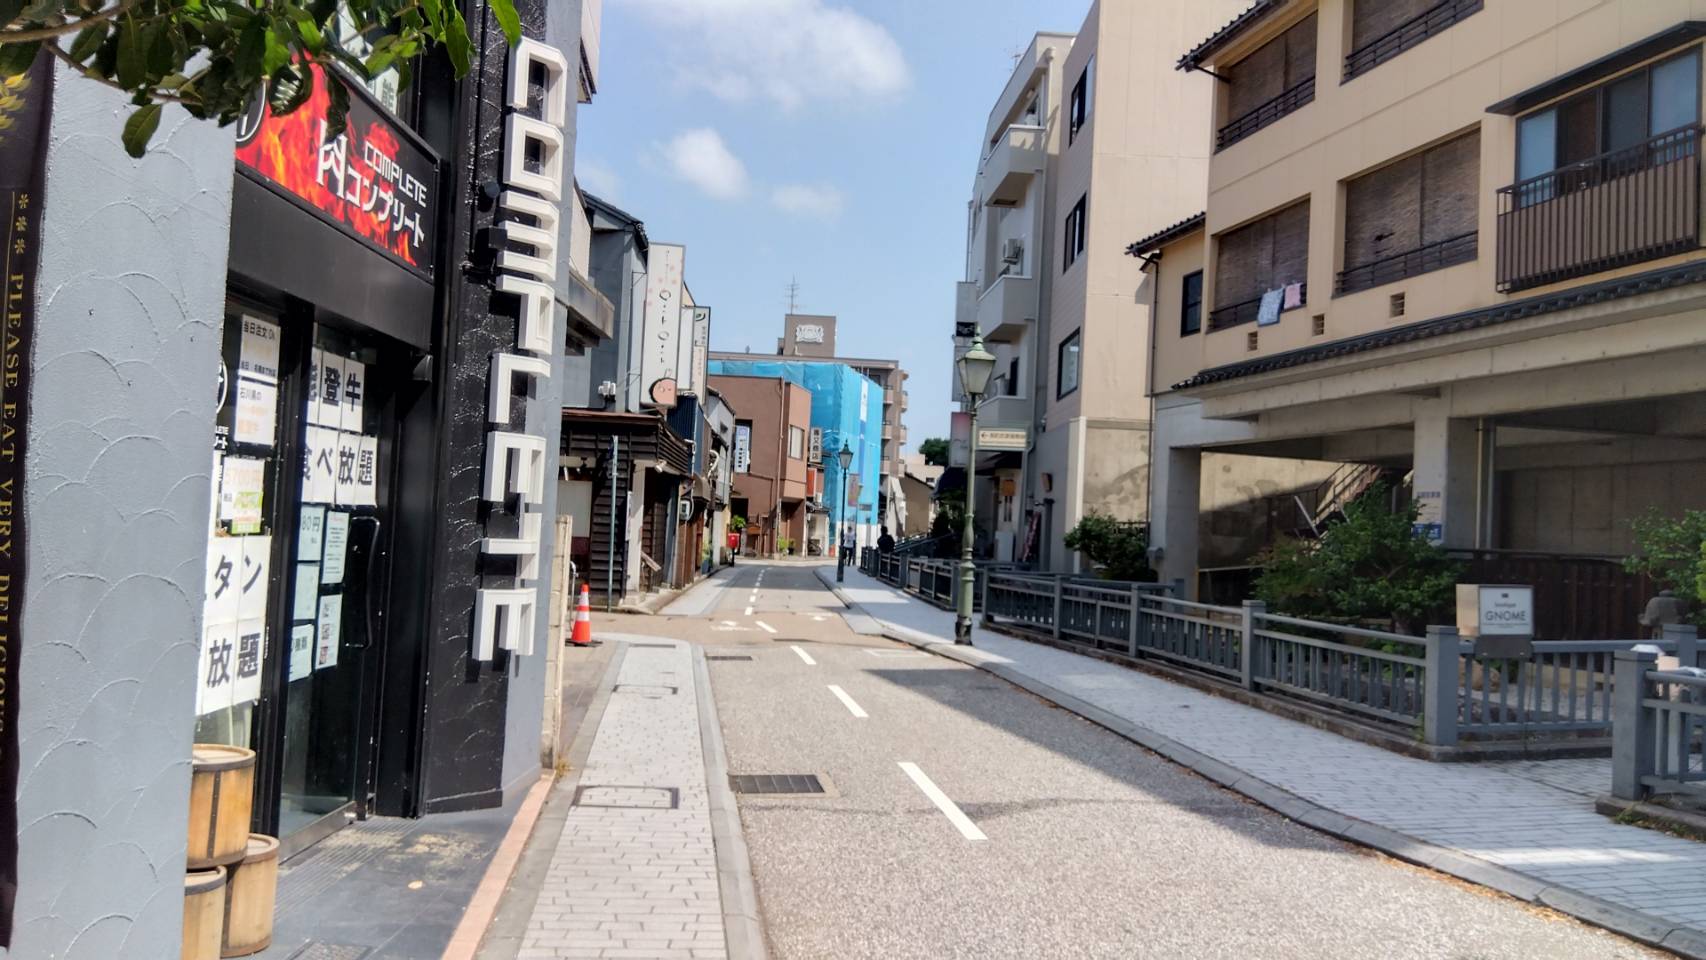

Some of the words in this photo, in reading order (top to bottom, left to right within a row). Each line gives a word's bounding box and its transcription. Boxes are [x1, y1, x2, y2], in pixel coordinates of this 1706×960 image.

[316, 118, 425, 248] 肉コンプリート
[364, 140, 427, 208] COMPLETE
[5, 274, 24, 388] PLEASE
[472, 35, 569, 661] COMPLETE
[1, 402, 17, 462] EAT
[1485, 610, 1527, 621] GNOME
[206, 632, 261, 689] 放題
